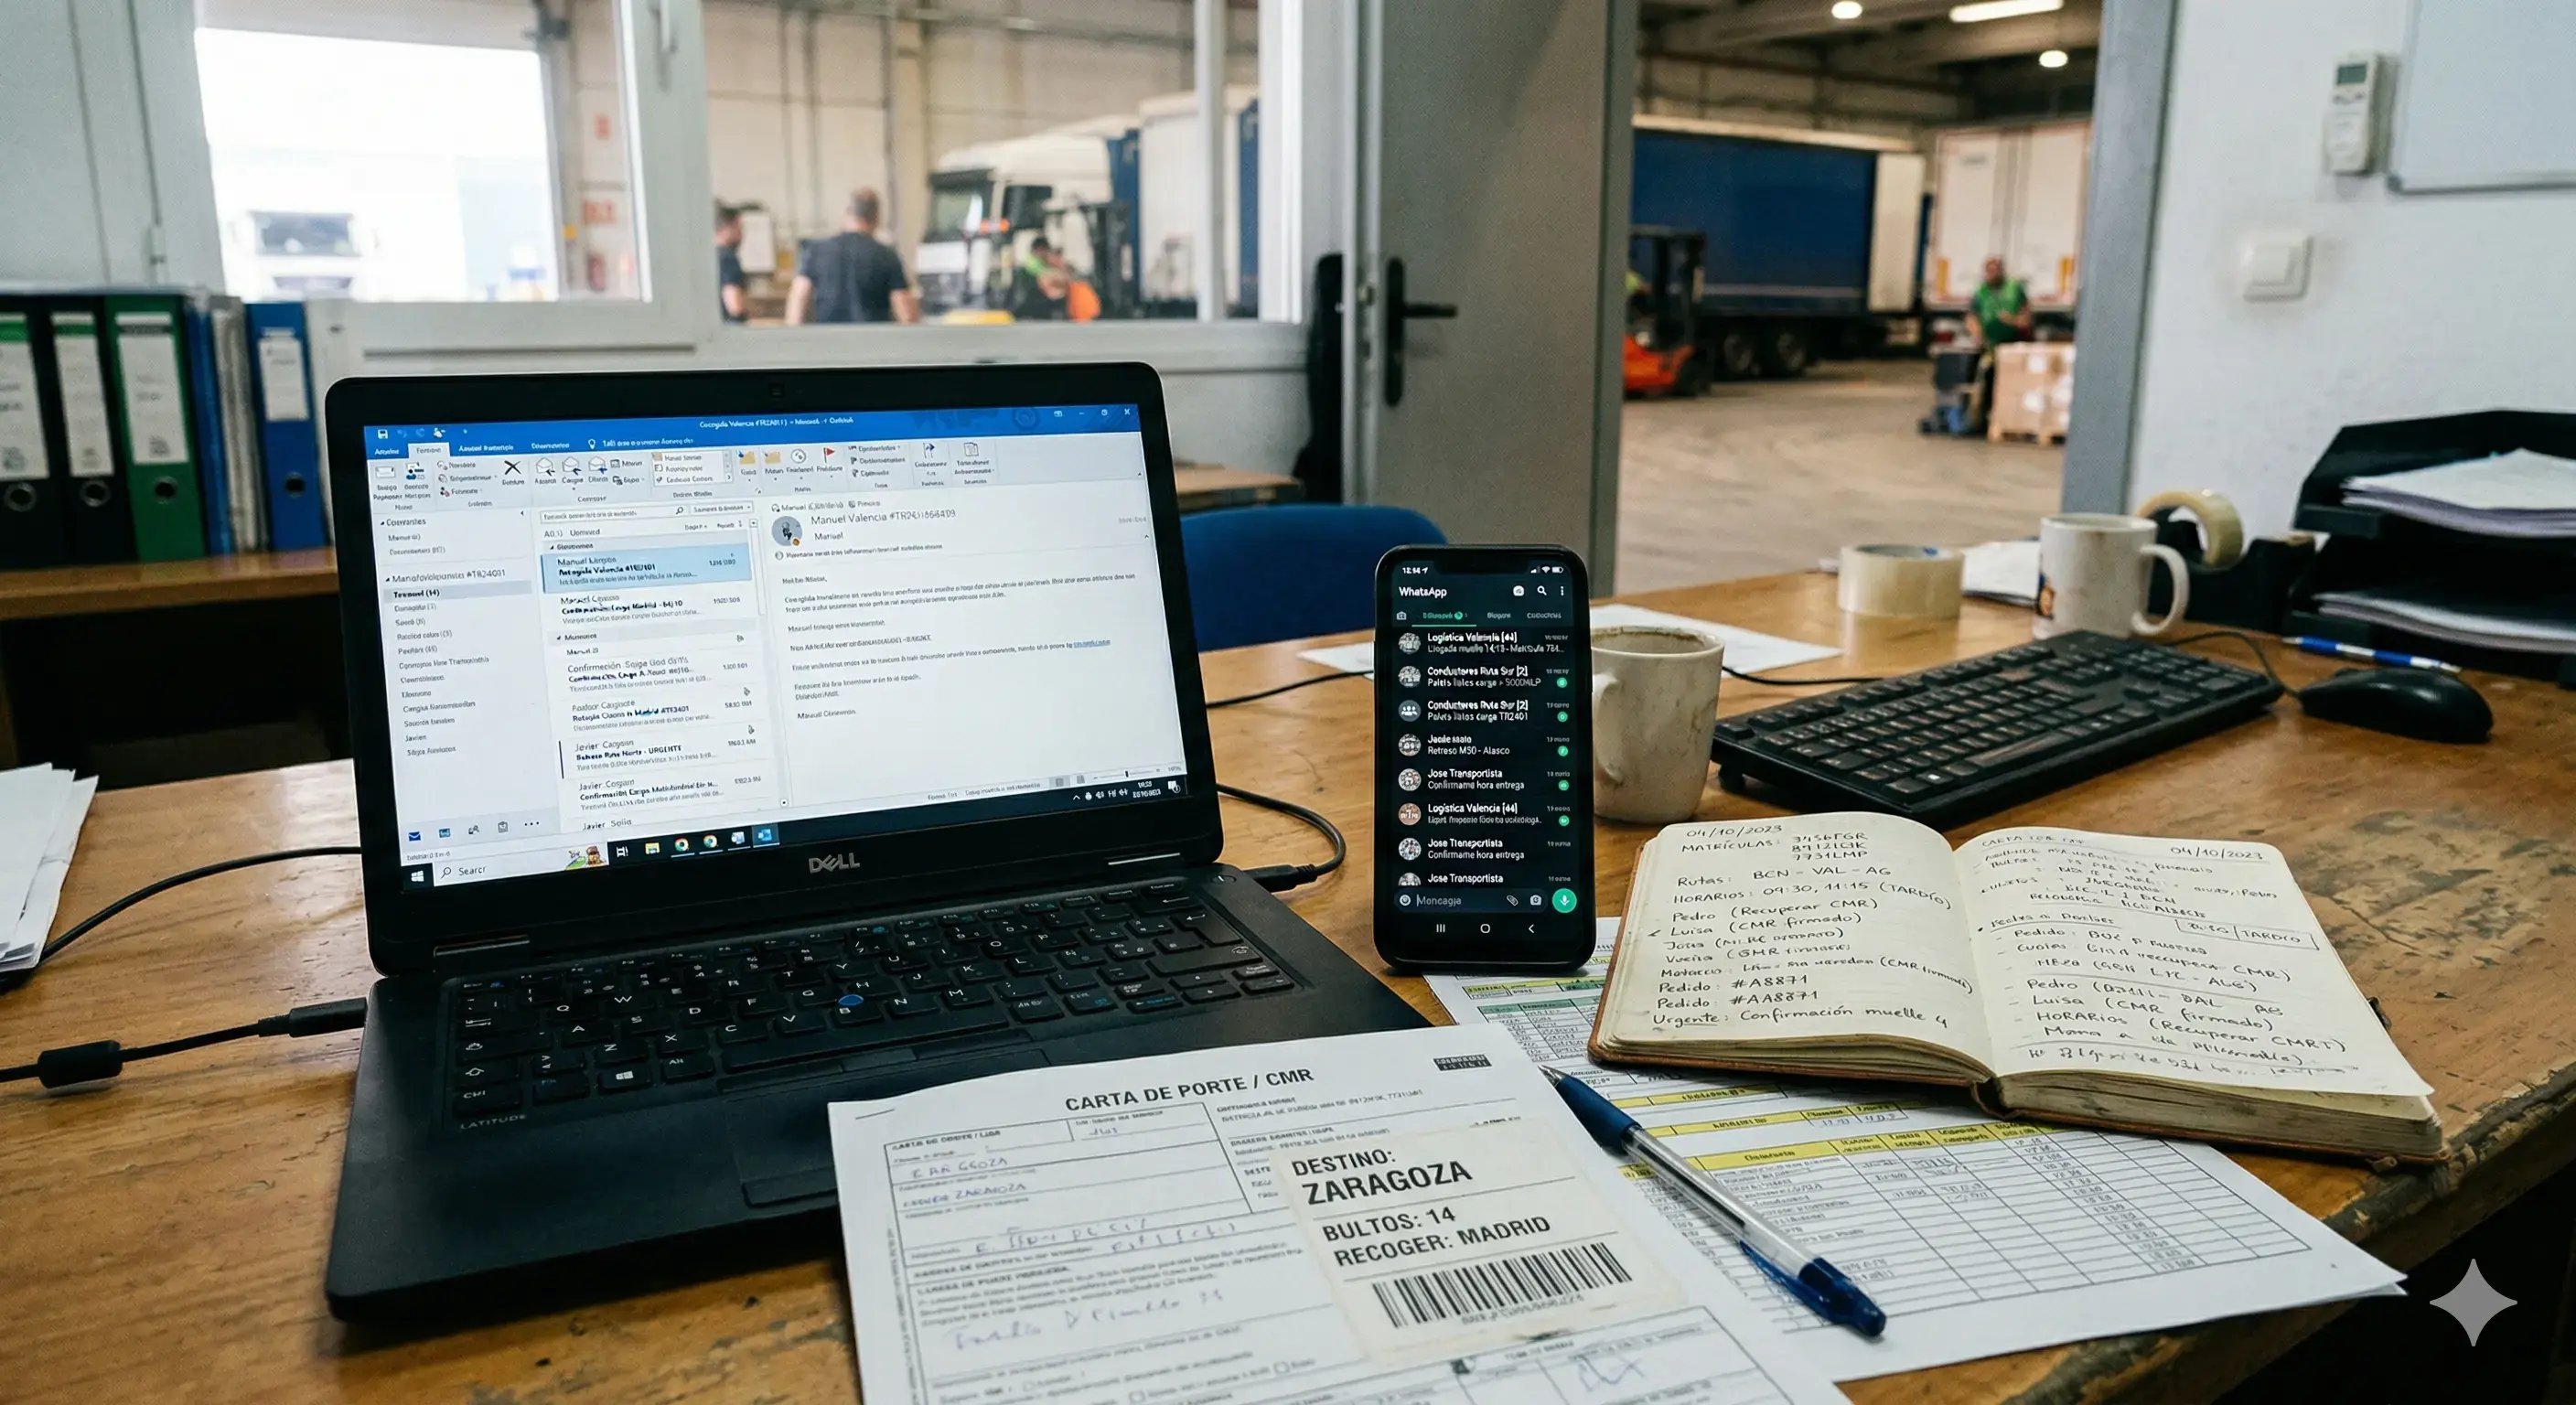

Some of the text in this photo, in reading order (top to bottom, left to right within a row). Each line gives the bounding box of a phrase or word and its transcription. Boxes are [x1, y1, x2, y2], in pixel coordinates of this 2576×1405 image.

[811, 513, 887, 525] Manuel Valencia
[1398, 586, 1447, 599] WhatsApp
[1427, 768, 1448, 778] Jose
[1476, 780, 1494, 789] hora
[1427, 839, 1448, 848] Jose
[809, 852, 861, 874] DELL
[1753, 869, 1789, 880] BCN
[1812, 867, 1847, 875] VAL
[1866, 866, 1892, 875] AG
[1672, 897, 1879, 923] Pedro (Recuperar CMR)
[1670, 927, 1713, 937] Luisa
[1729, 919, 1776, 934] (CMR
[2026, 978, 2078, 990] Pedro
[614, 995, 632, 1003] W
[2033, 994, 2085, 1006] Luisa
[2105, 997, 2165, 1014] (CMR
[1740, 1006, 1853, 1024] Confirmación
[572, 1024, 585, 1033] A
[724, 1024, 737, 1033] C
[2149, 1017, 2259, 1043] (Recuperar
[664, 1034, 678, 1043] X
[604, 1044, 617, 1052] Z
[1065, 1067, 1315, 1111] CARTA DE PORTE / CMR
[460, 1113, 528, 1131] LATITUDE
[1291, 1146, 1397, 1177] DESTINO:
[1302, 1159, 1475, 1207] ZARAGOZA
[1323, 1206, 1456, 1243] BULTOS: 14
[1334, 1215, 1551, 1268] RECOGER: MADRID
